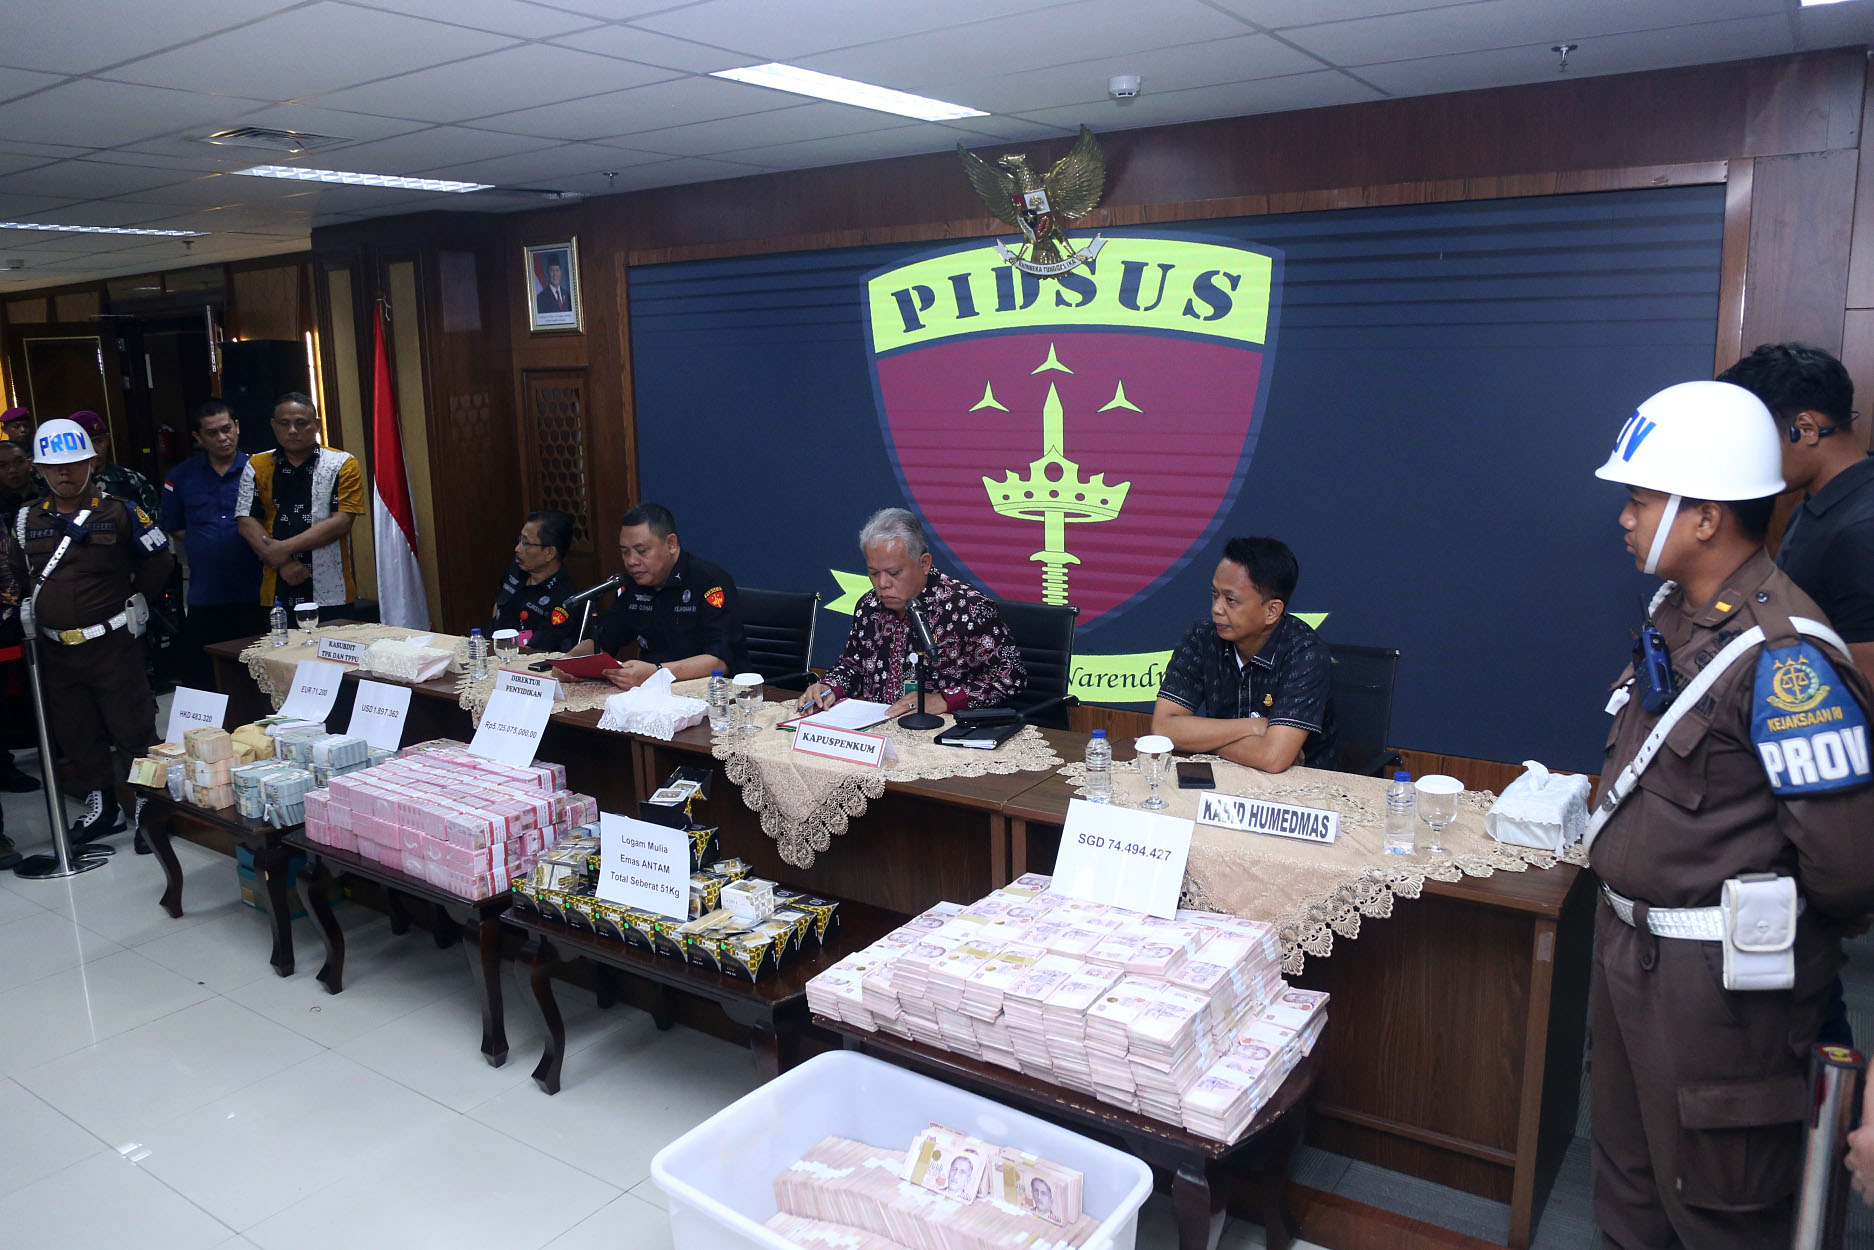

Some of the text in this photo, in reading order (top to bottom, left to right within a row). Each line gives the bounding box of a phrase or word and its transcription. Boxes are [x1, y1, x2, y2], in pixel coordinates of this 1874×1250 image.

[891, 258, 1242, 333] PIDSUS
[39, 432, 87, 456] PROV
[321, 650, 359, 663] TPK DAN TPPU
[328, 641, 356, 652] KASUBDIT
[300, 685, 328, 697] EUR 71.200
[505, 684, 542, 699] PENYIDIKAN
[511, 674, 541, 687] DIREKTUR
[179, 711, 213, 723] HKD 483.320
[361, 703, 399, 719] USD 1.897.362
[1767, 706, 1844, 733] KEJAKSAAN RI
[802, 732, 876, 754] KAPUSPENKUM
[1757, 725, 1870, 788] PROV
[1248, 803, 1331, 840] HUMEDMAS
[621, 834, 669, 855] Logam Mulia
[1077, 833, 1172, 862] SGD 74.494.427
[620, 853, 671, 875] Emas ANTAM
[610, 871, 680, 899] Total Seberat 51Kg
